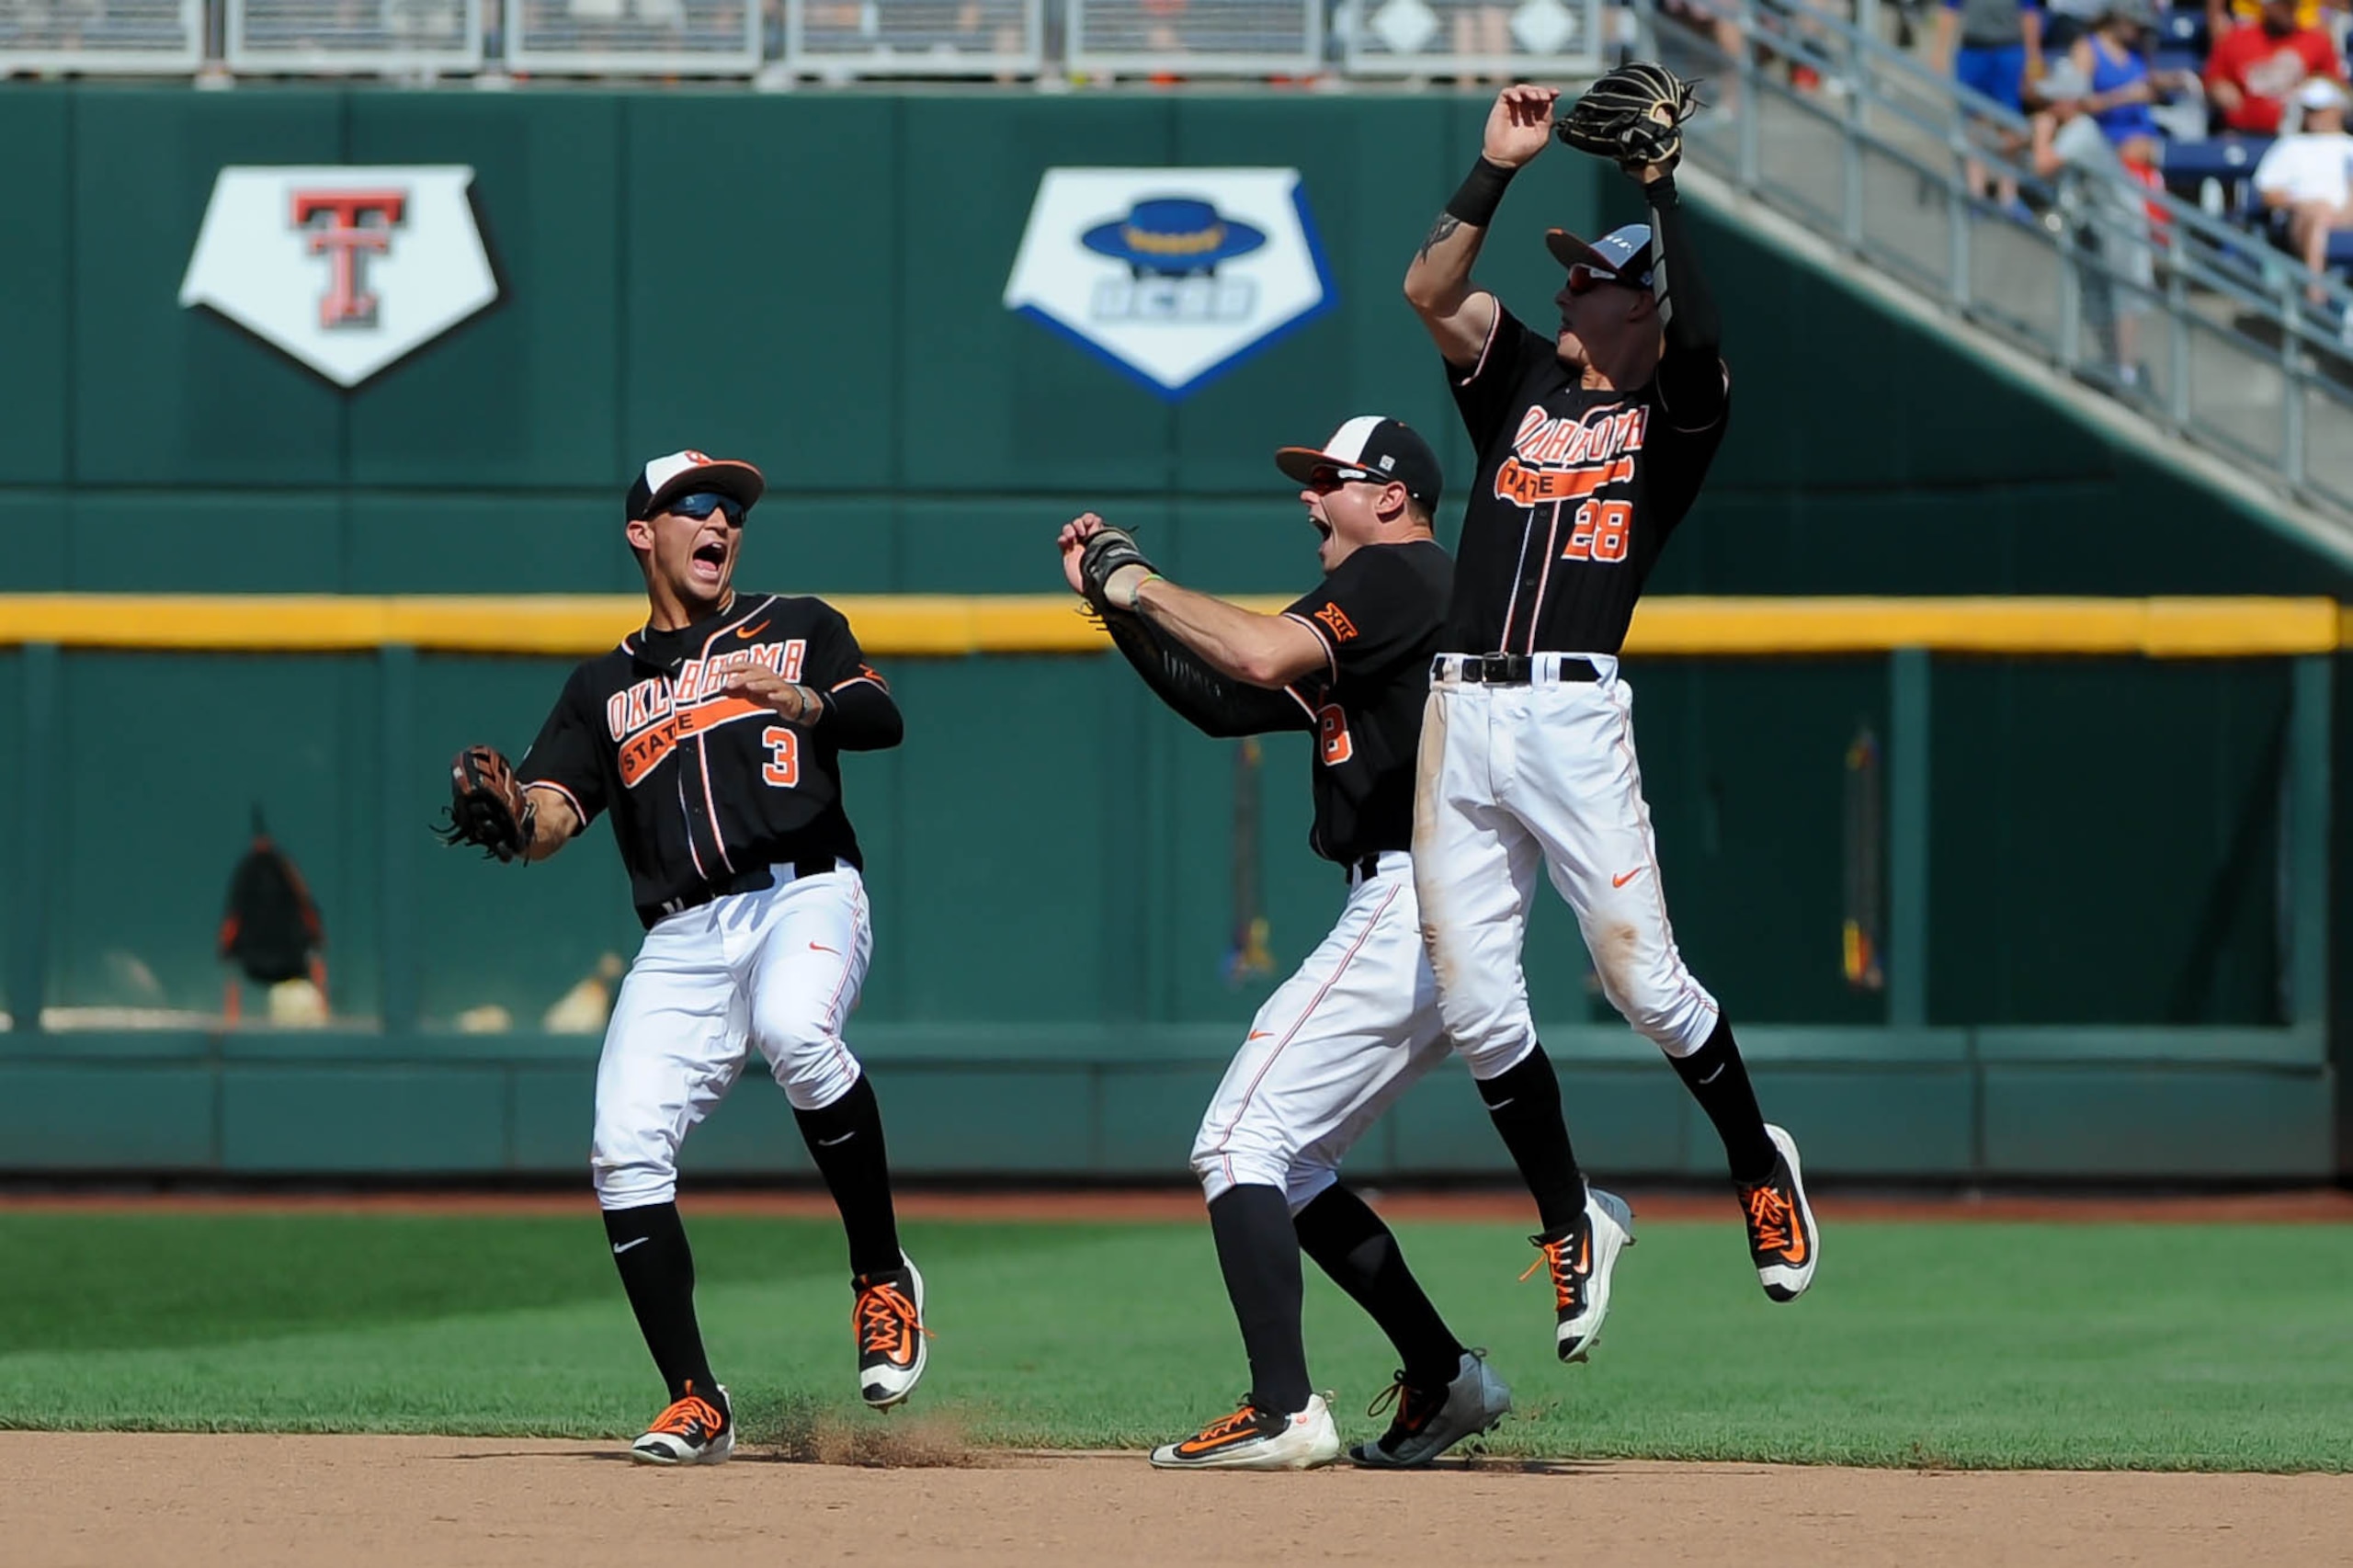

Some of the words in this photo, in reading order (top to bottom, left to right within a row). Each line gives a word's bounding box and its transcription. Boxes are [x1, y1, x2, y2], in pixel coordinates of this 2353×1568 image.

[1561, 498, 1632, 562] 28
[623, 714, 695, 772] STATE
[762, 726, 800, 788] 3
